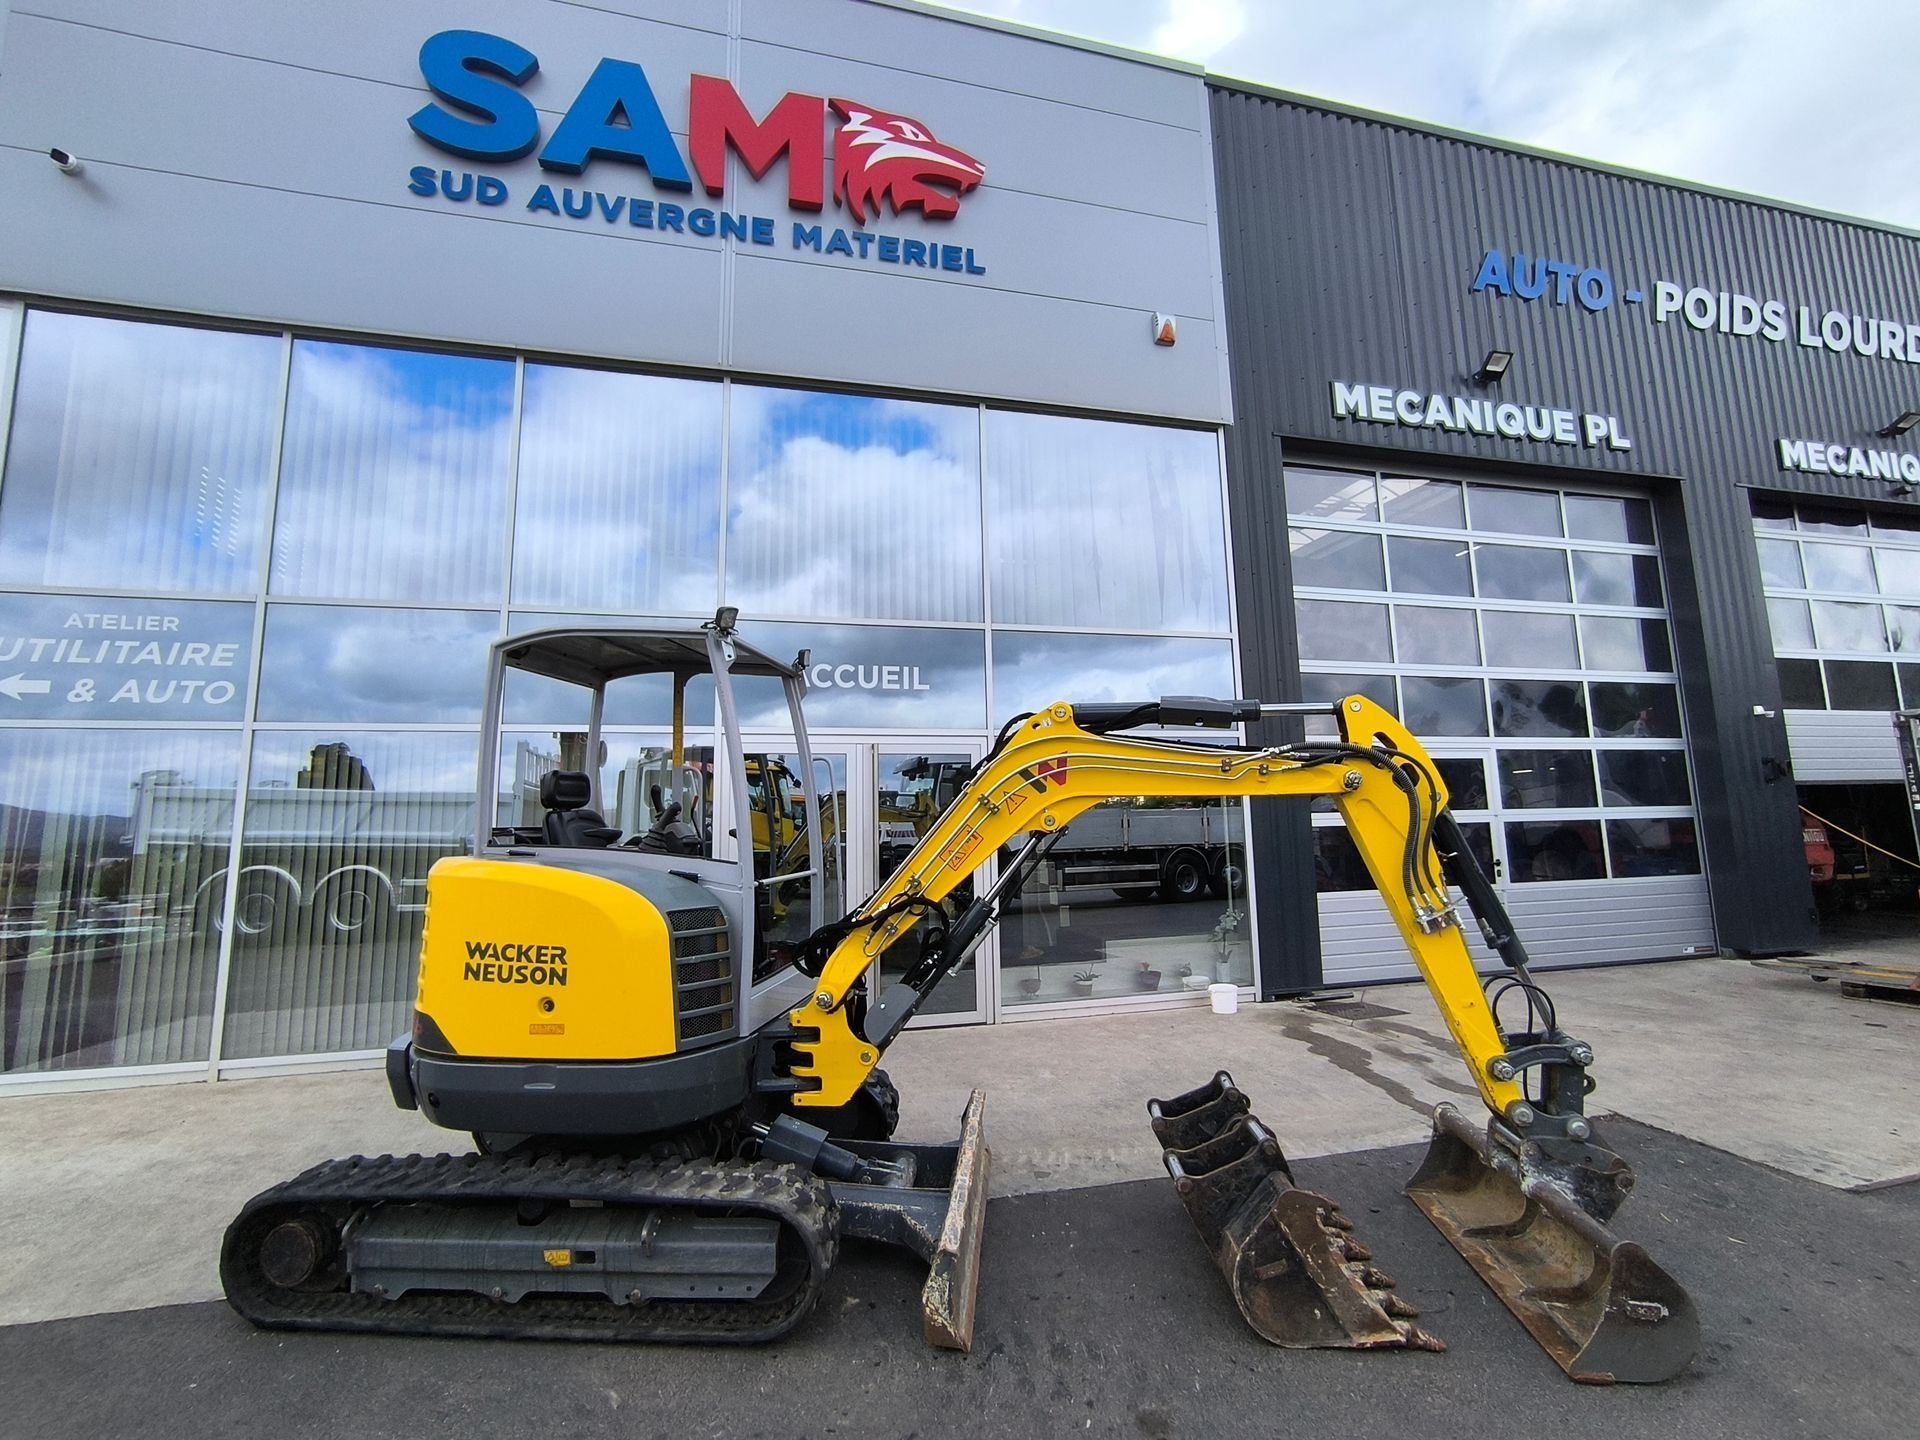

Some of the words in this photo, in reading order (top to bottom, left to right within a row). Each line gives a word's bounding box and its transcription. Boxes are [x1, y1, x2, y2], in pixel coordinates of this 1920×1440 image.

[407, 29, 824, 212] SAM
[408, 165, 508, 205] SUD
[527, 184, 775, 245] AUVERGNE
[792, 222, 987, 275] MATERIEL
[1473, 250, 1613, 312] AUTO
[1656, 280, 1787, 342] POIDS
[1331, 381, 1578, 444] MECANIQUE
[1584, 412, 1632, 451] PL
[1780, 438, 1920, 484] MECANIQ
[63, 613, 180, 632] ATELIER
[0, 637, 239, 667] UTILITAIRE
[67, 678, 97, 703] &
[109, 679, 235, 704] AUTO
[465, 941, 568, 966] WACKER
[464, 962, 567, 986] NEUSON
